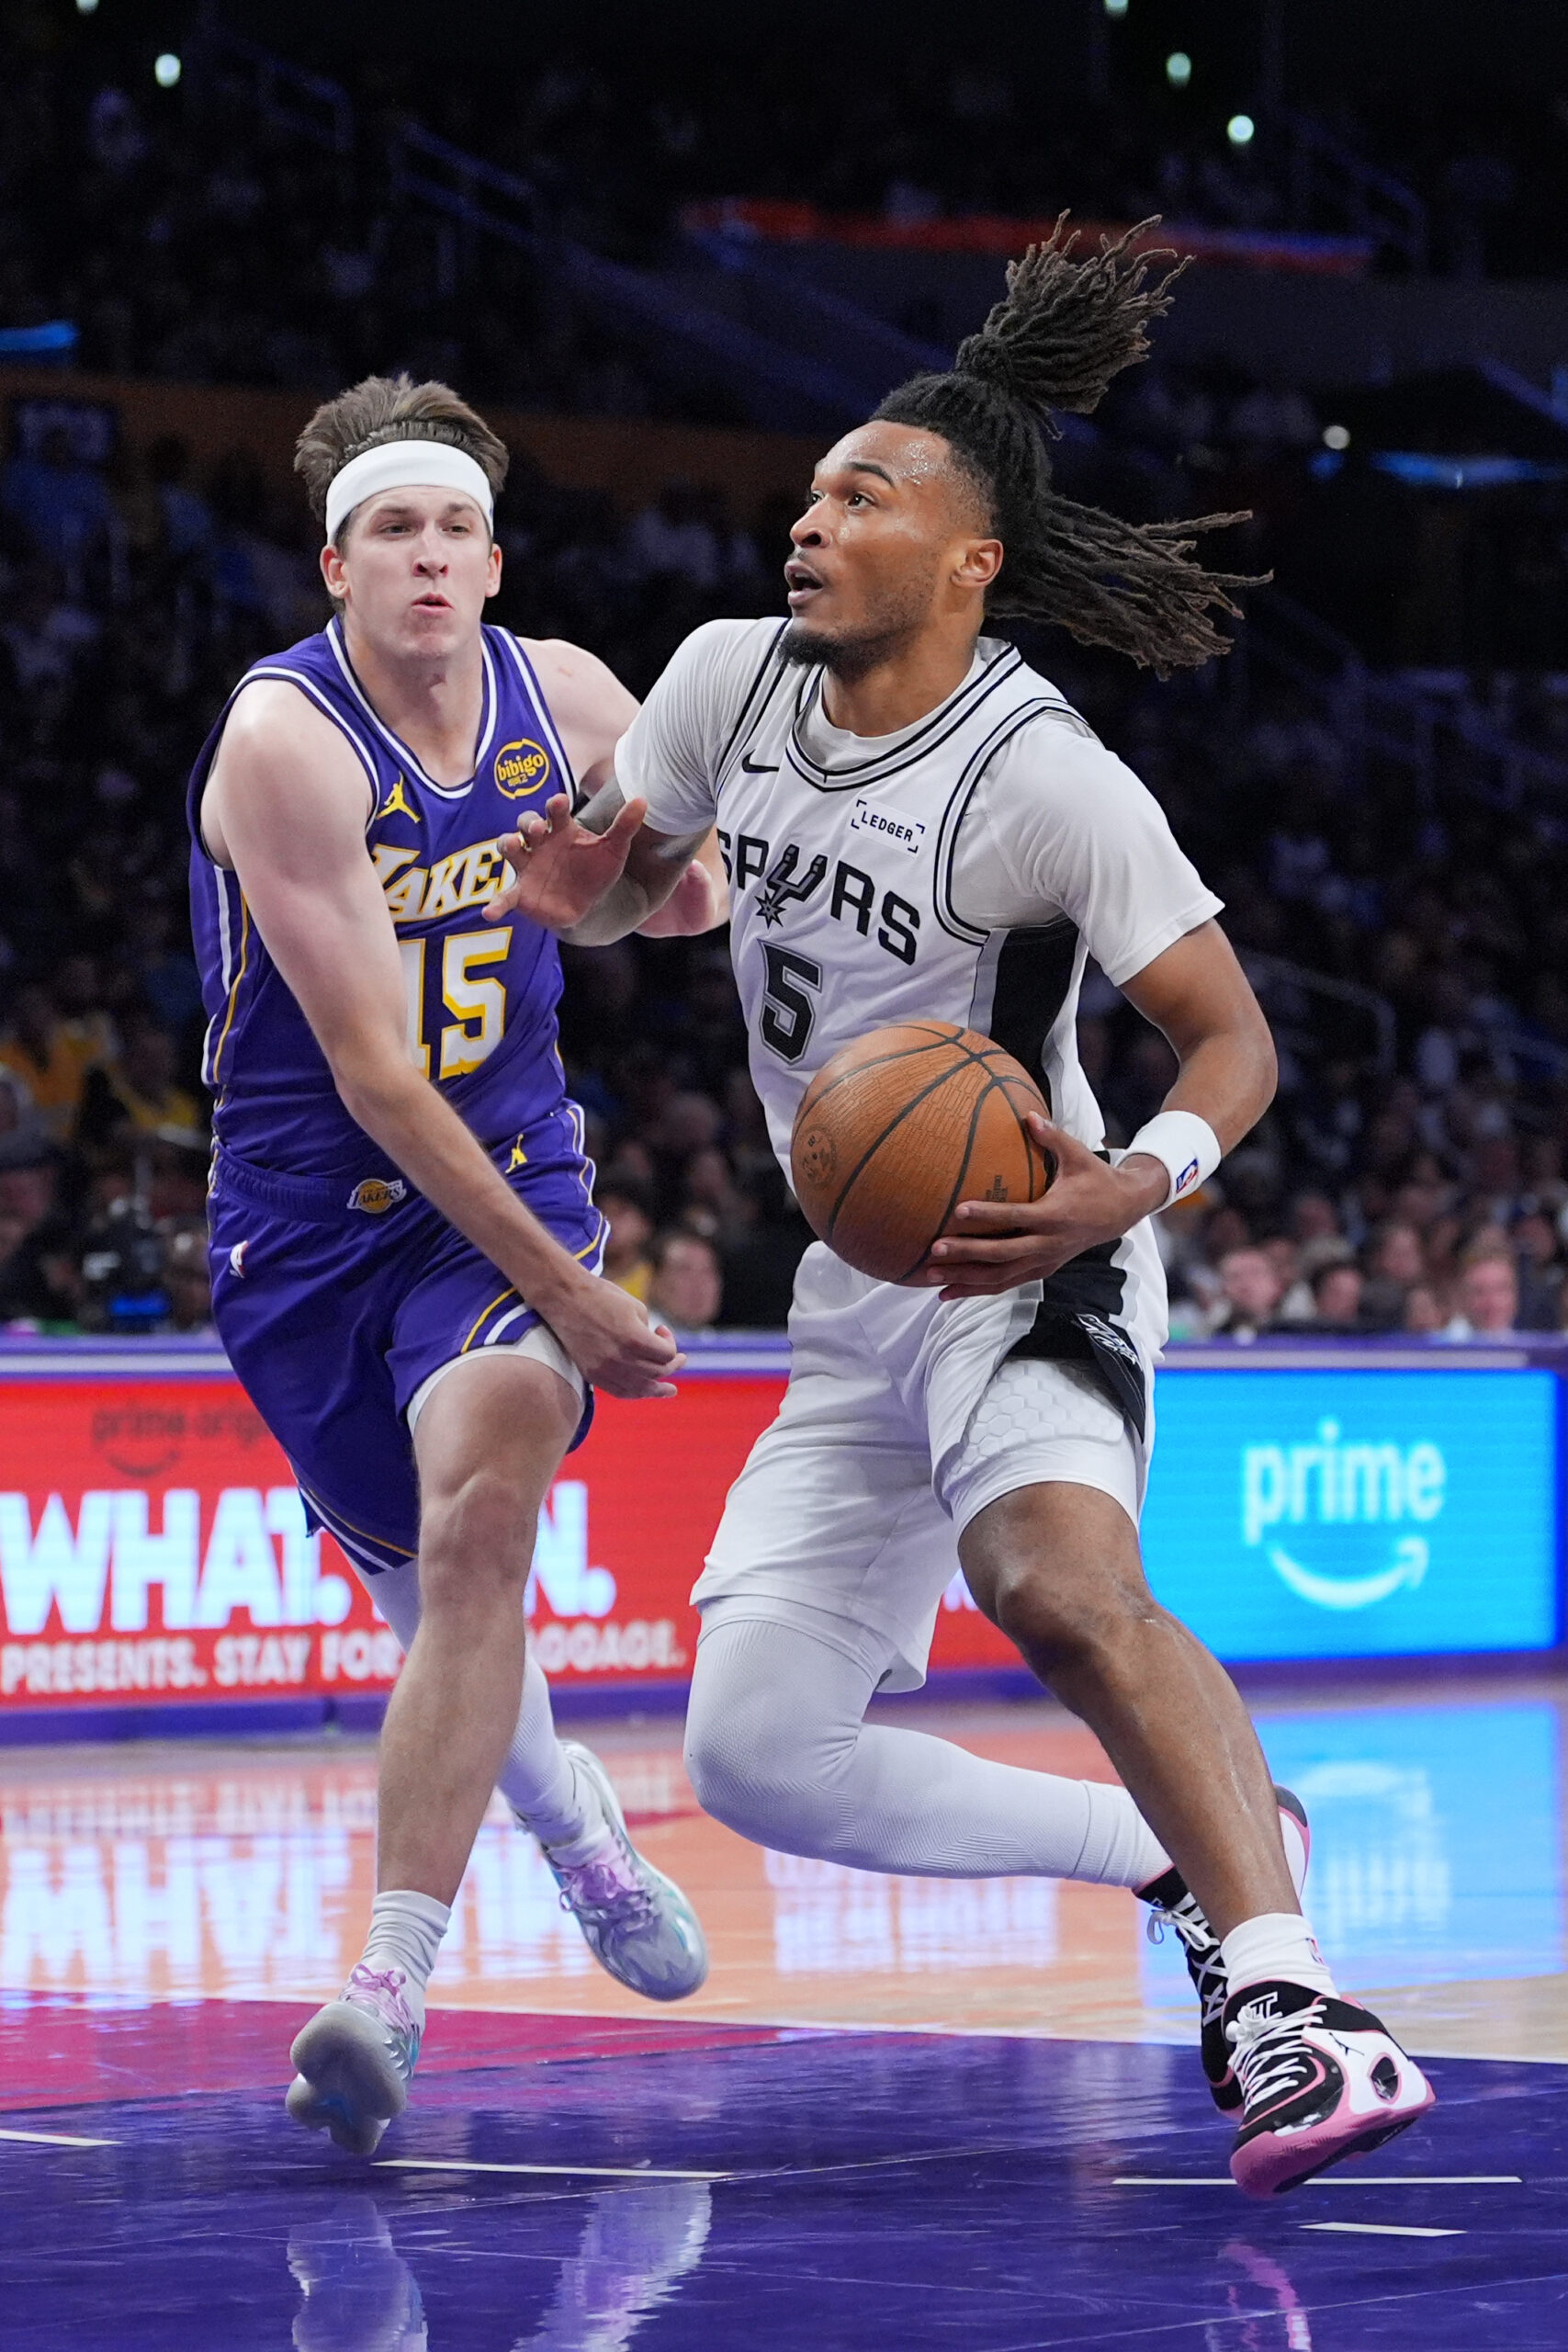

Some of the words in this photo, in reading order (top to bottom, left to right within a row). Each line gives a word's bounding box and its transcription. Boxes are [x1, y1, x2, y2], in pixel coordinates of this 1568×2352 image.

[497, 753, 546, 781] bibigo
[370, 831, 525, 922] LAKE
[861, 810, 914, 842] LEDGER
[398, 925, 513, 1082] 15
[756, 938, 824, 1066] 5
[1243, 1415, 1447, 1547] prime
[0, 1487, 353, 1635] WHAT.
[1, 1636, 209, 1695] PRESENTS.
[214, 1634, 310, 1687] STAY
[527, 1619, 687, 1673] GGAGE.
